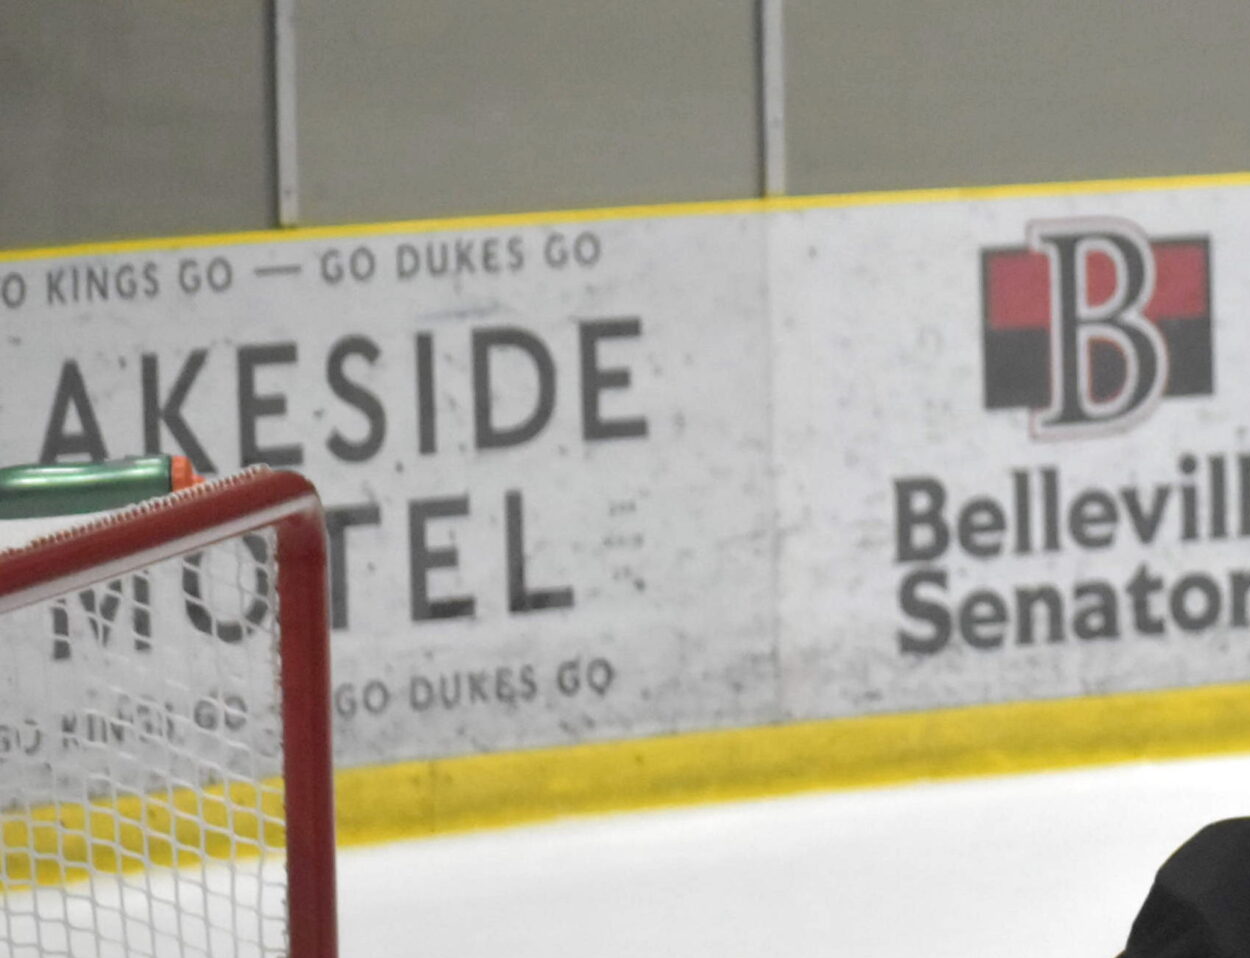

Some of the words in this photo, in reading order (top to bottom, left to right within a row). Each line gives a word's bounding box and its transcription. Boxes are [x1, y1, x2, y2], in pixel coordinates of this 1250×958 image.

[46, 262, 160, 304] KINGS
[178, 256, 233, 294] GO
[320, 247, 377, 284] GO
[397, 239, 524, 278] DUKES
[544, 231, 602, 268] GO
[1028, 217, 1168, 441] B
[337, 679, 391, 718] GO
[409, 665, 537, 712] DUKES
[557, 657, 616, 697] GO
